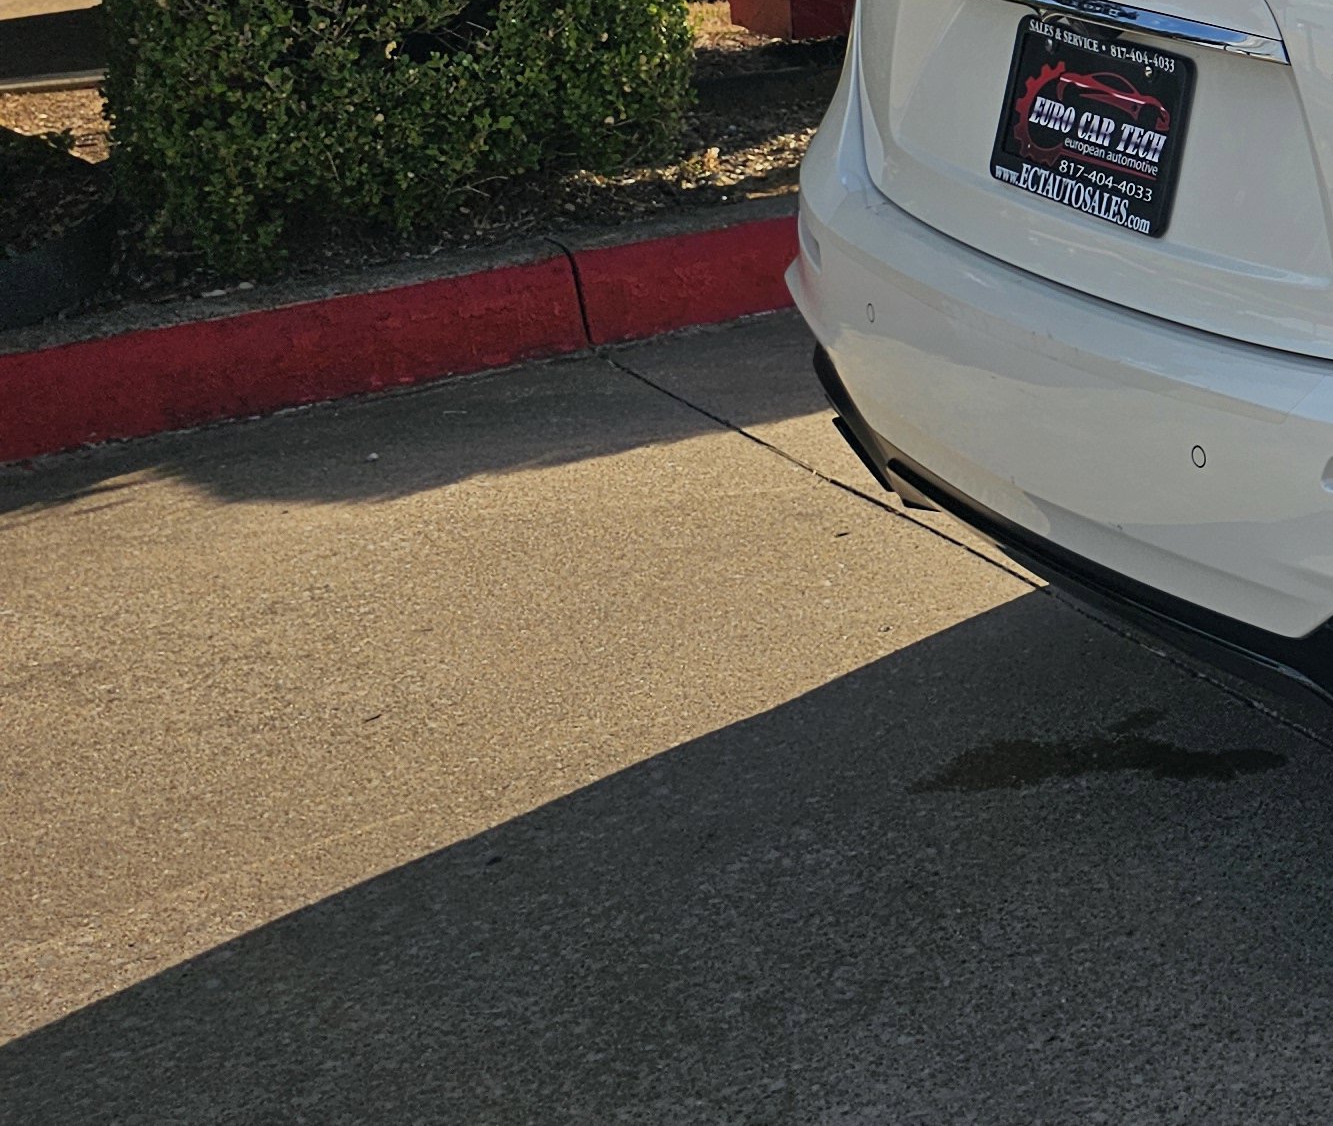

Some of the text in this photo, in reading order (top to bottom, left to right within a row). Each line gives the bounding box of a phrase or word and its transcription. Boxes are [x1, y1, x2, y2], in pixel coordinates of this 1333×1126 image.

[1029, 19, 1175, 73] SALES & SERVICE 817-404-4033
[1029, 96, 1167, 163] EURO CAR TECH
[1064, 137, 1159, 176] european automotive
[995, 163, 1150, 234] www.ECTAUTOSALES.com
[1058, 159, 1153, 202] 817-404-4033
